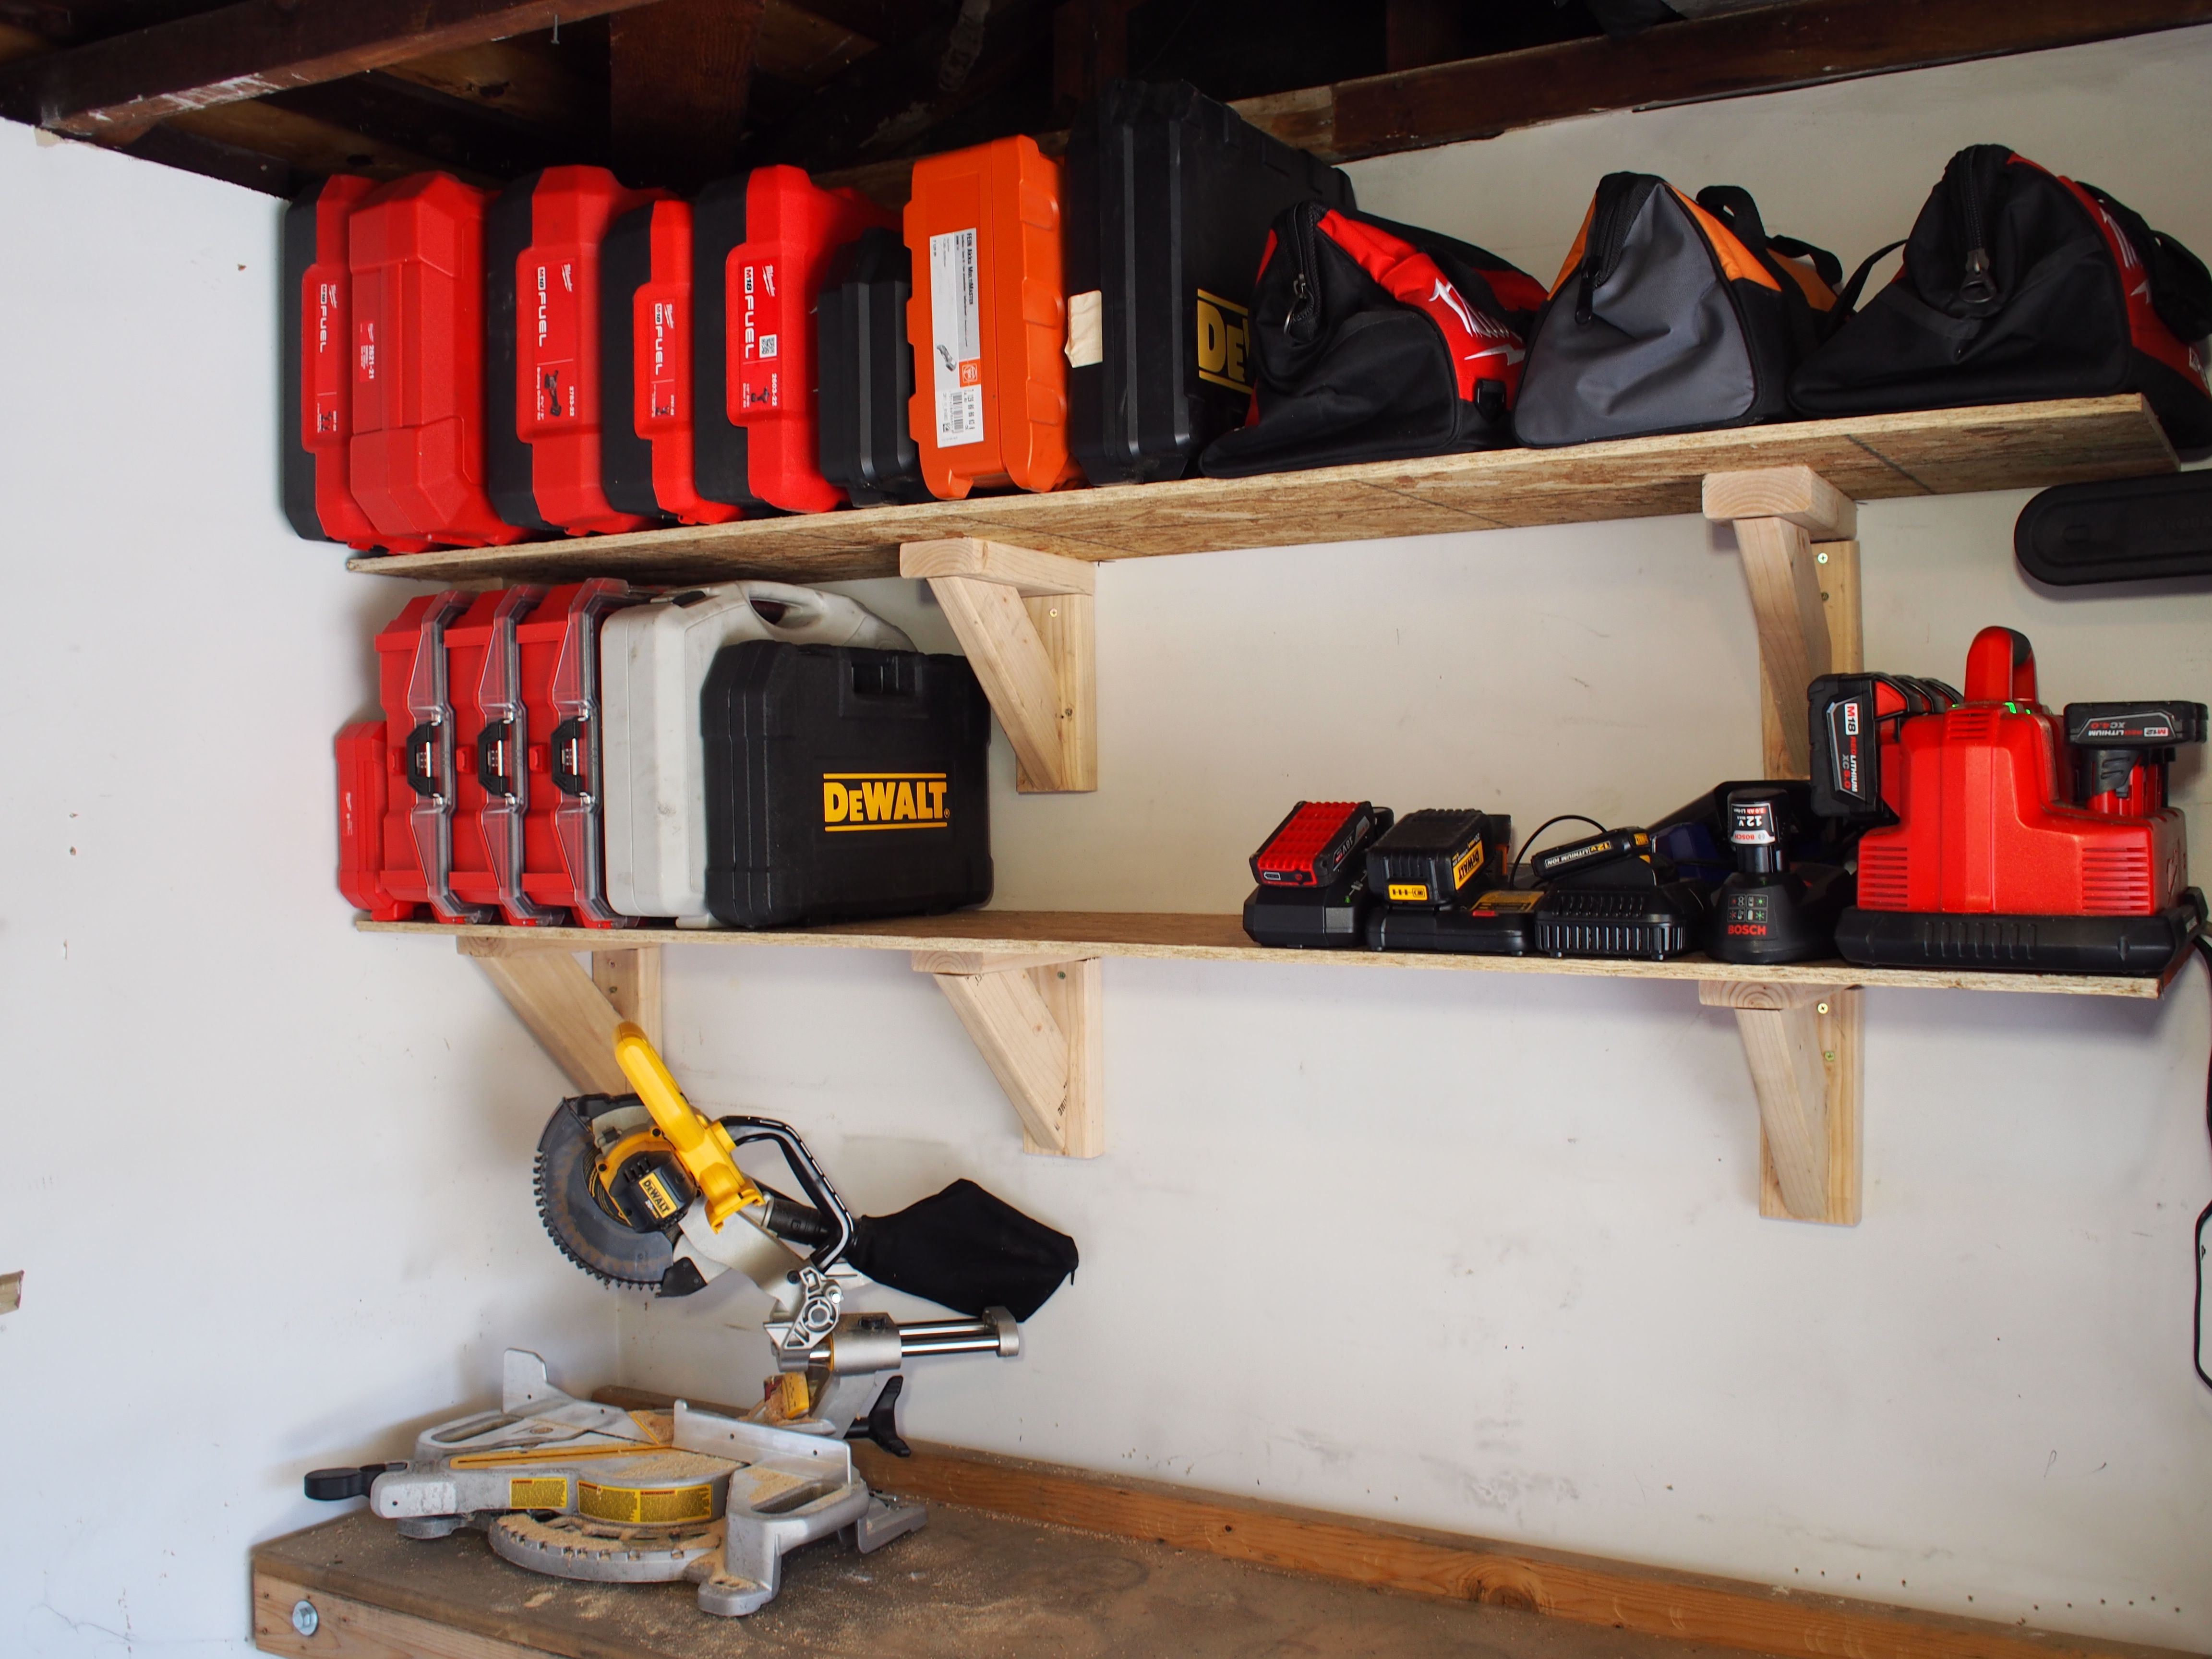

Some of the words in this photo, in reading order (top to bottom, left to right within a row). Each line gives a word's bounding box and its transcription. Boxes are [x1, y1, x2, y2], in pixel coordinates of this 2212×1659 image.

[745, 267, 753, 293] M18
[538, 292, 547, 347] FUEL
[745, 295, 755, 359] FUEL
[1197, 299, 1250, 382] DE
[1846, 705, 1857, 733] M18
[1746, 816, 1762, 827] 12
[1547, 857, 1560, 866] ION
[1561, 848, 1588, 861] LITHIUM
[1728, 923, 1767, 937] BOSCH
